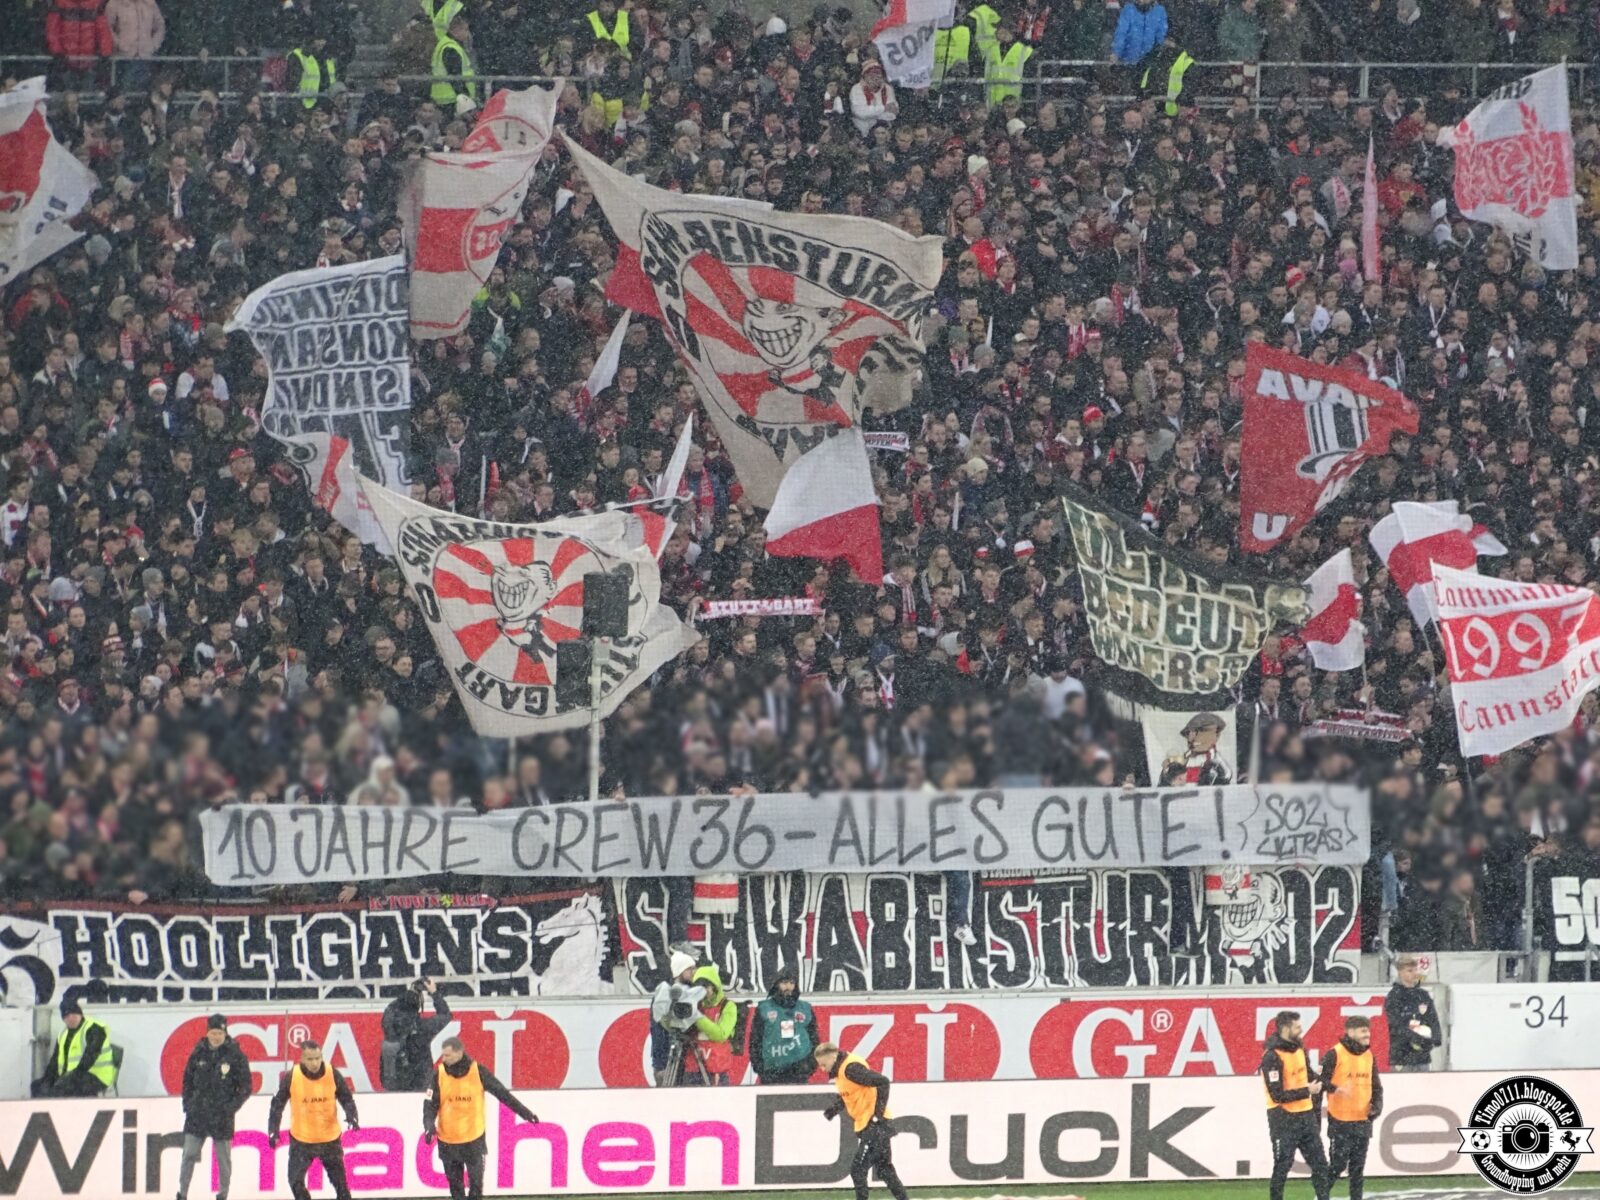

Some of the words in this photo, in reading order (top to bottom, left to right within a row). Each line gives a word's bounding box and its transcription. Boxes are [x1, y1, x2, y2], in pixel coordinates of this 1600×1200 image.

[218, 806, 277, 880] 10
[290, 805, 481, 877] JAHRE
[511, 799, 682, 873] CREW
[689, 797, 776, 870] 36
[828, 790, 1009, 867] ALLES
[1032, 788, 1232, 863] GUTE!
[48, 906, 533, 985] HOOLIGANS
